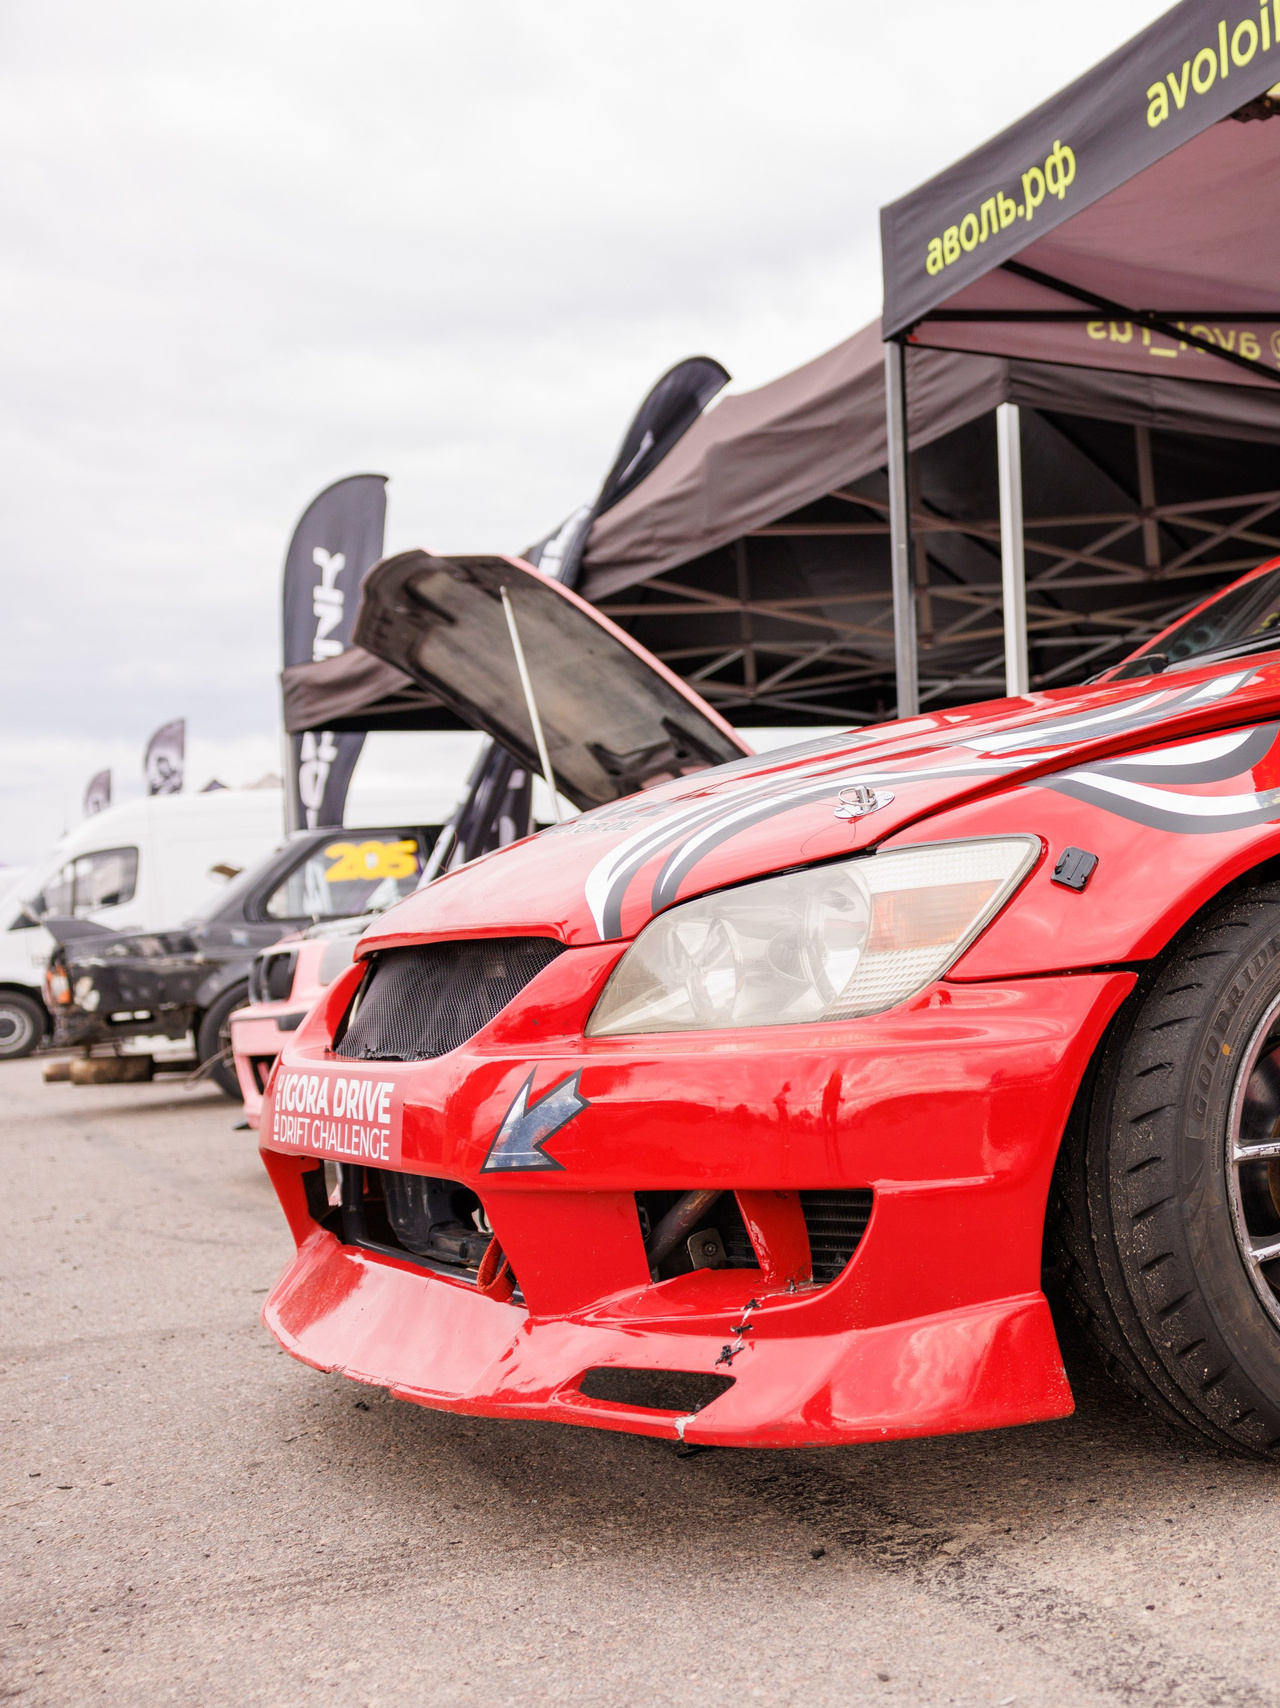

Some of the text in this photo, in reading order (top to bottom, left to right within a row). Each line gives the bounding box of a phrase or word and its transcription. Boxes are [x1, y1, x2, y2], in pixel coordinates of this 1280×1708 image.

[925, 140, 1077, 275] аволь.рф
[324, 839, 418, 883] 205
[281, 1073, 395, 1124] IGORA DRIVE
[280, 1115, 390, 1161] DRIFT CHALLENGE
